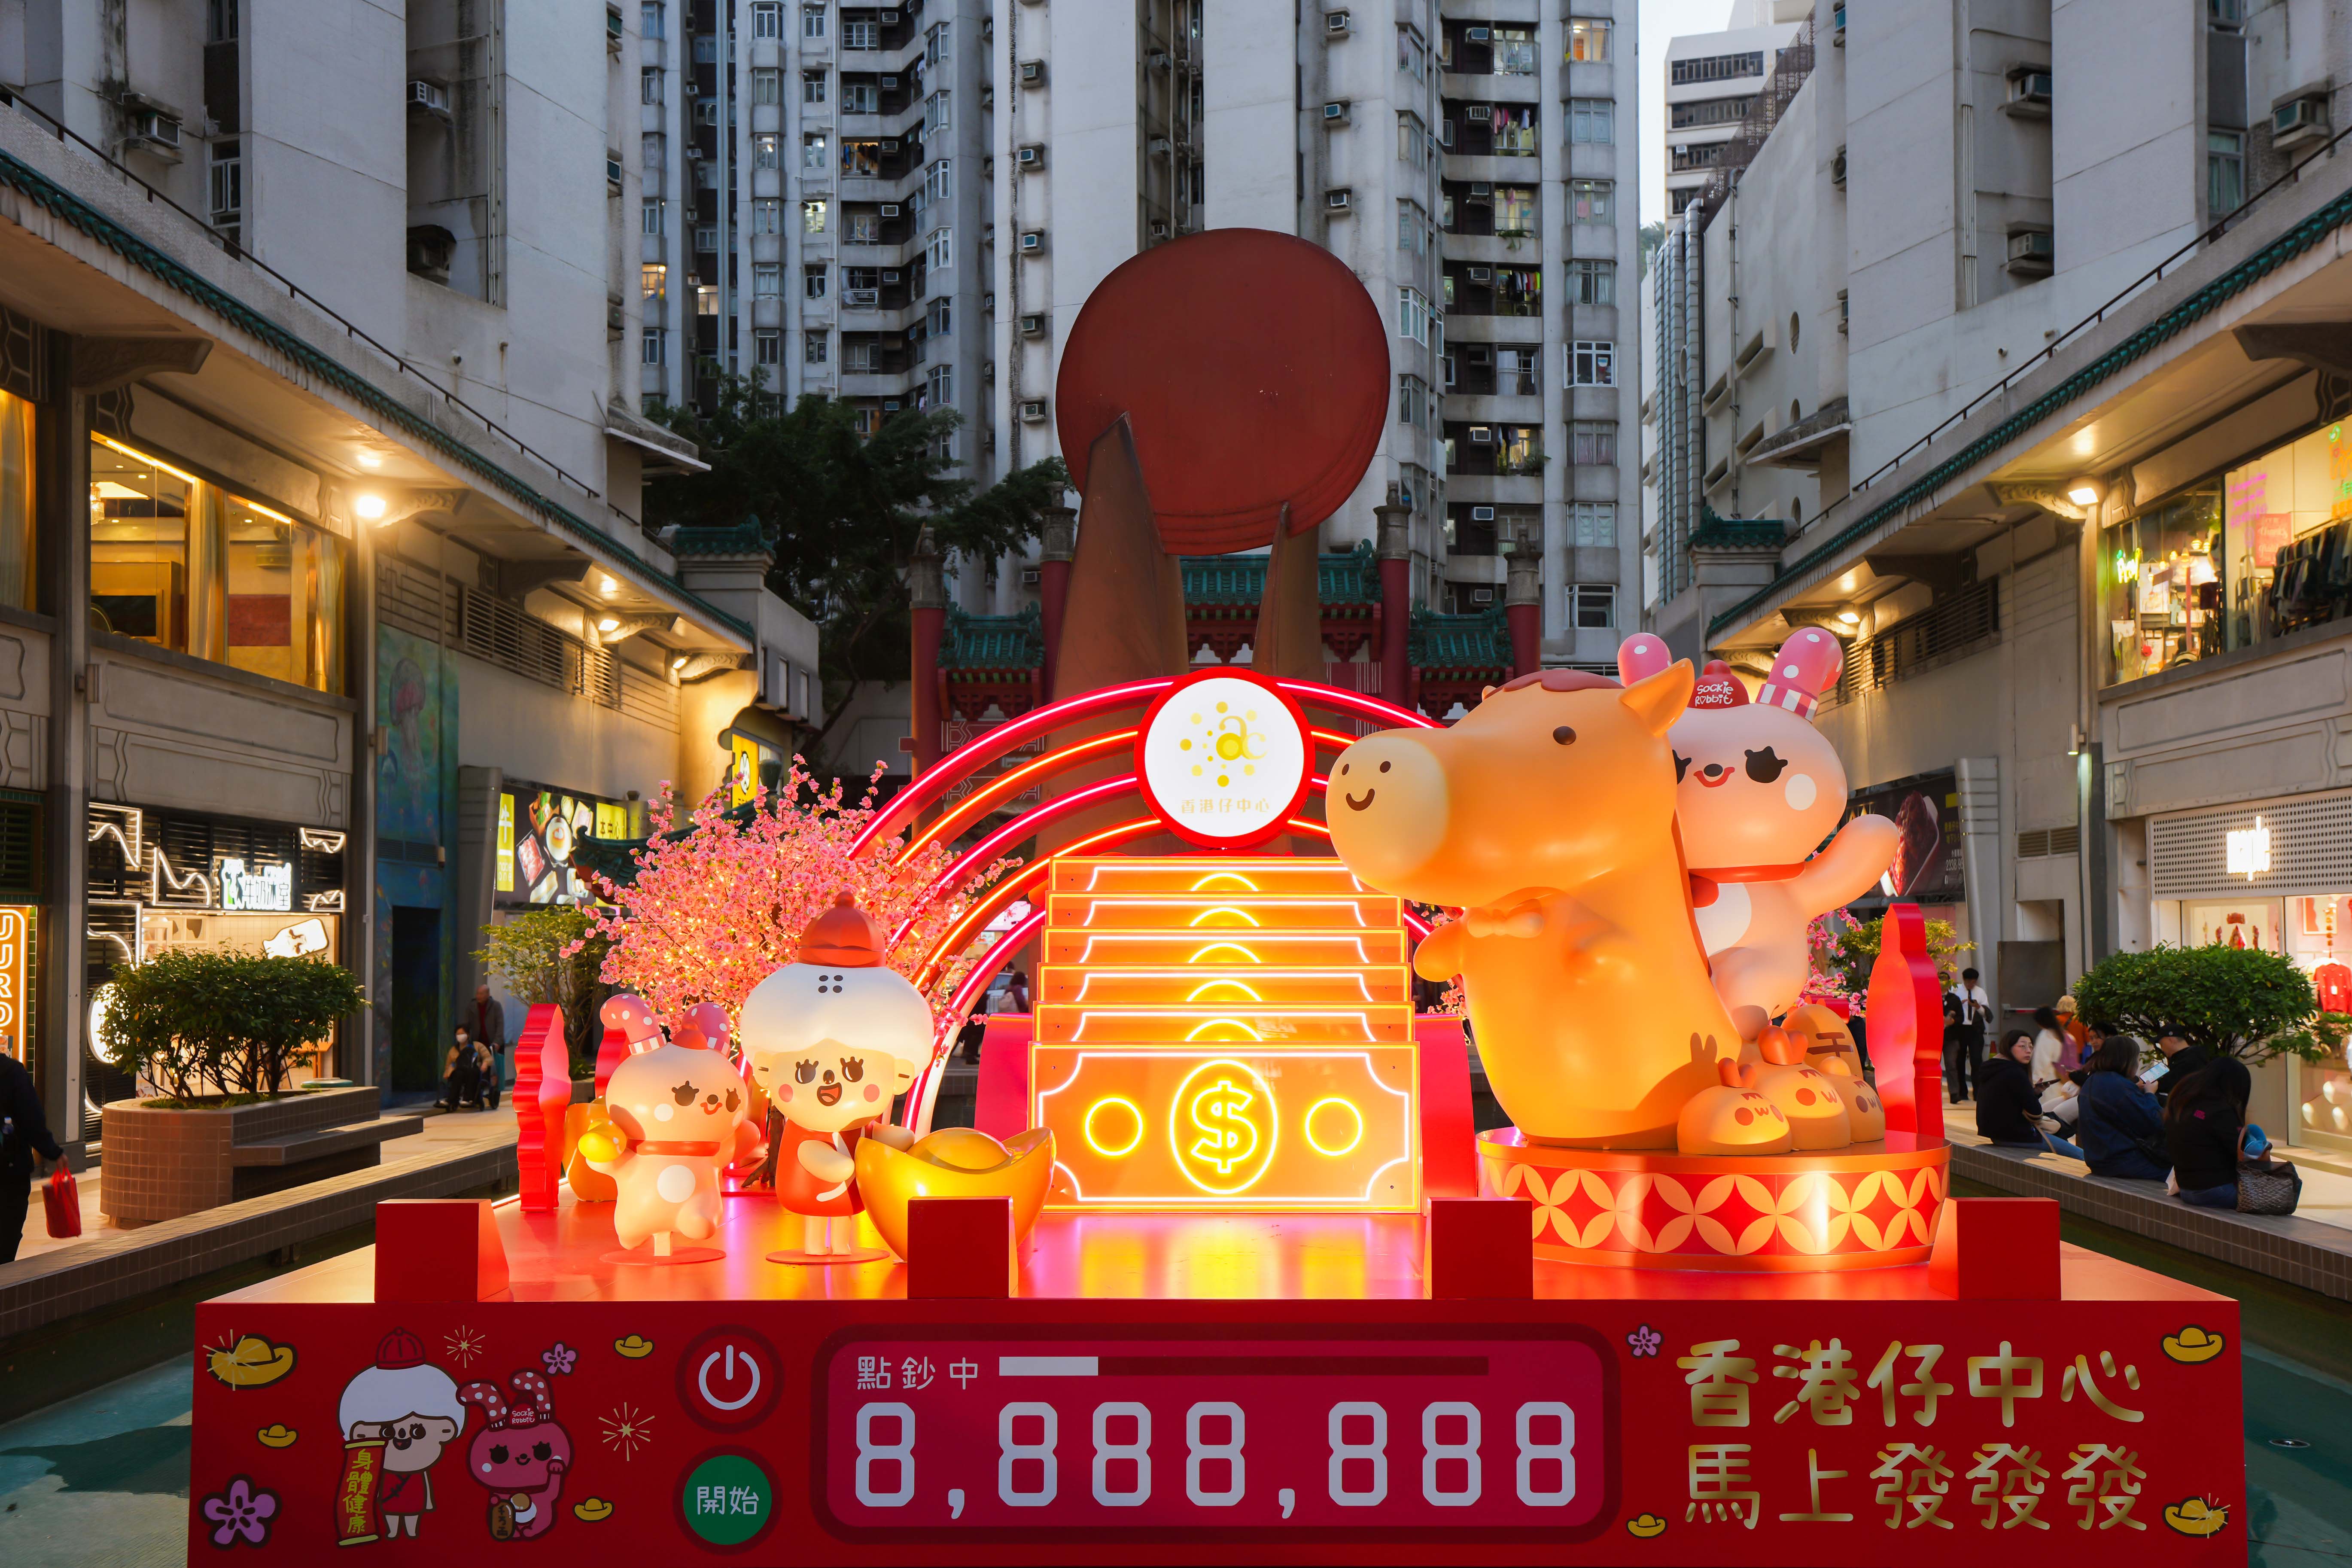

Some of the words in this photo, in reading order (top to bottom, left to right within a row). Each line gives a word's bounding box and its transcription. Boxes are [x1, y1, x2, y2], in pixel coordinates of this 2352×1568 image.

[1181, 798, 1270, 814] 香港仔中心
[857, 1356, 979, 1390] 點鈔中
[1676, 1337, 2145, 1428] 香港仔中心
[342, 1448, 374, 1534] 身體健康
[696, 1486, 760, 1515] 開始
[855, 1401, 1576, 1519] 8,888,888
[1684, 1443, 2147, 1531] 馬上發發發
